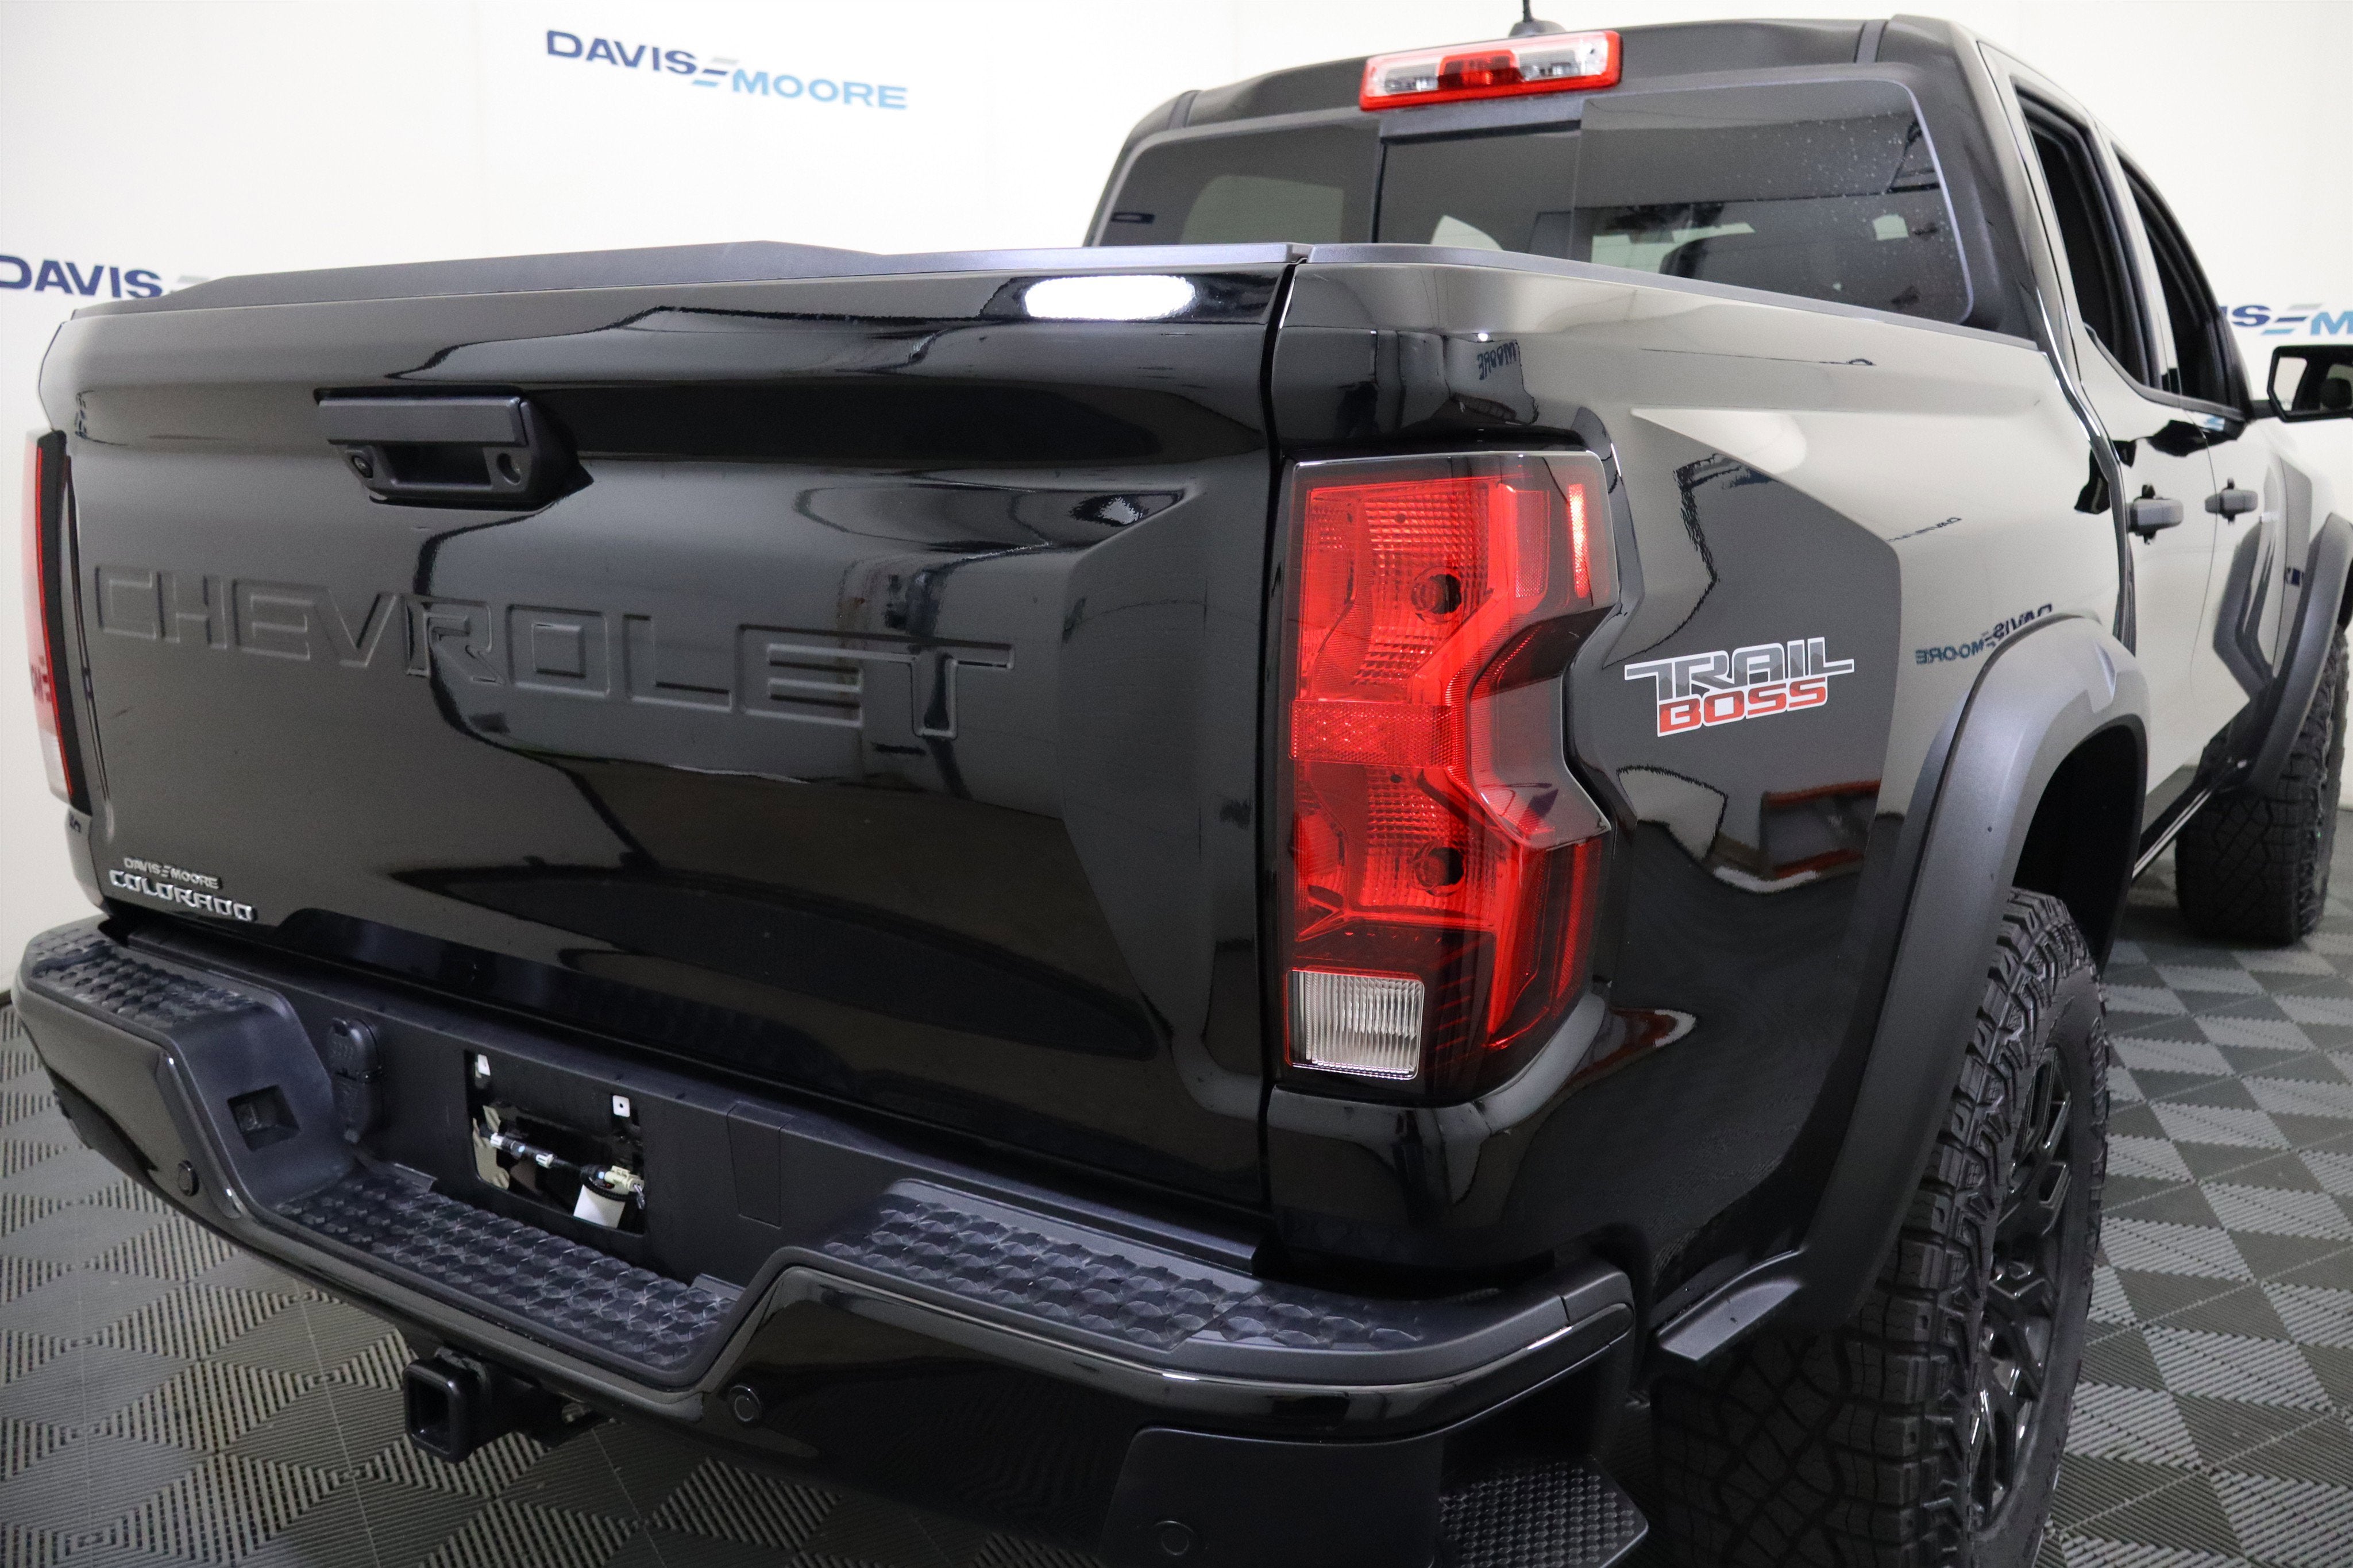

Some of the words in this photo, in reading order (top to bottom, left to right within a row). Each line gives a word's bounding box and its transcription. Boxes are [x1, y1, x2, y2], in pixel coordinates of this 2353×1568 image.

[546, 30, 697, 75] DAVIS
[732, 68, 908, 110] MOORE
[0, 254, 163, 299] DAVIS
[94, 565, 1016, 739] CHEVROLET
[1625, 636, 1854, 702] TRAIL
[1657, 676, 1828, 737] BOSS
[109, 869, 253, 921] COLORADO
[124, 857, 162, 874] DAVIS
[170, 867, 219, 889] MOORE
